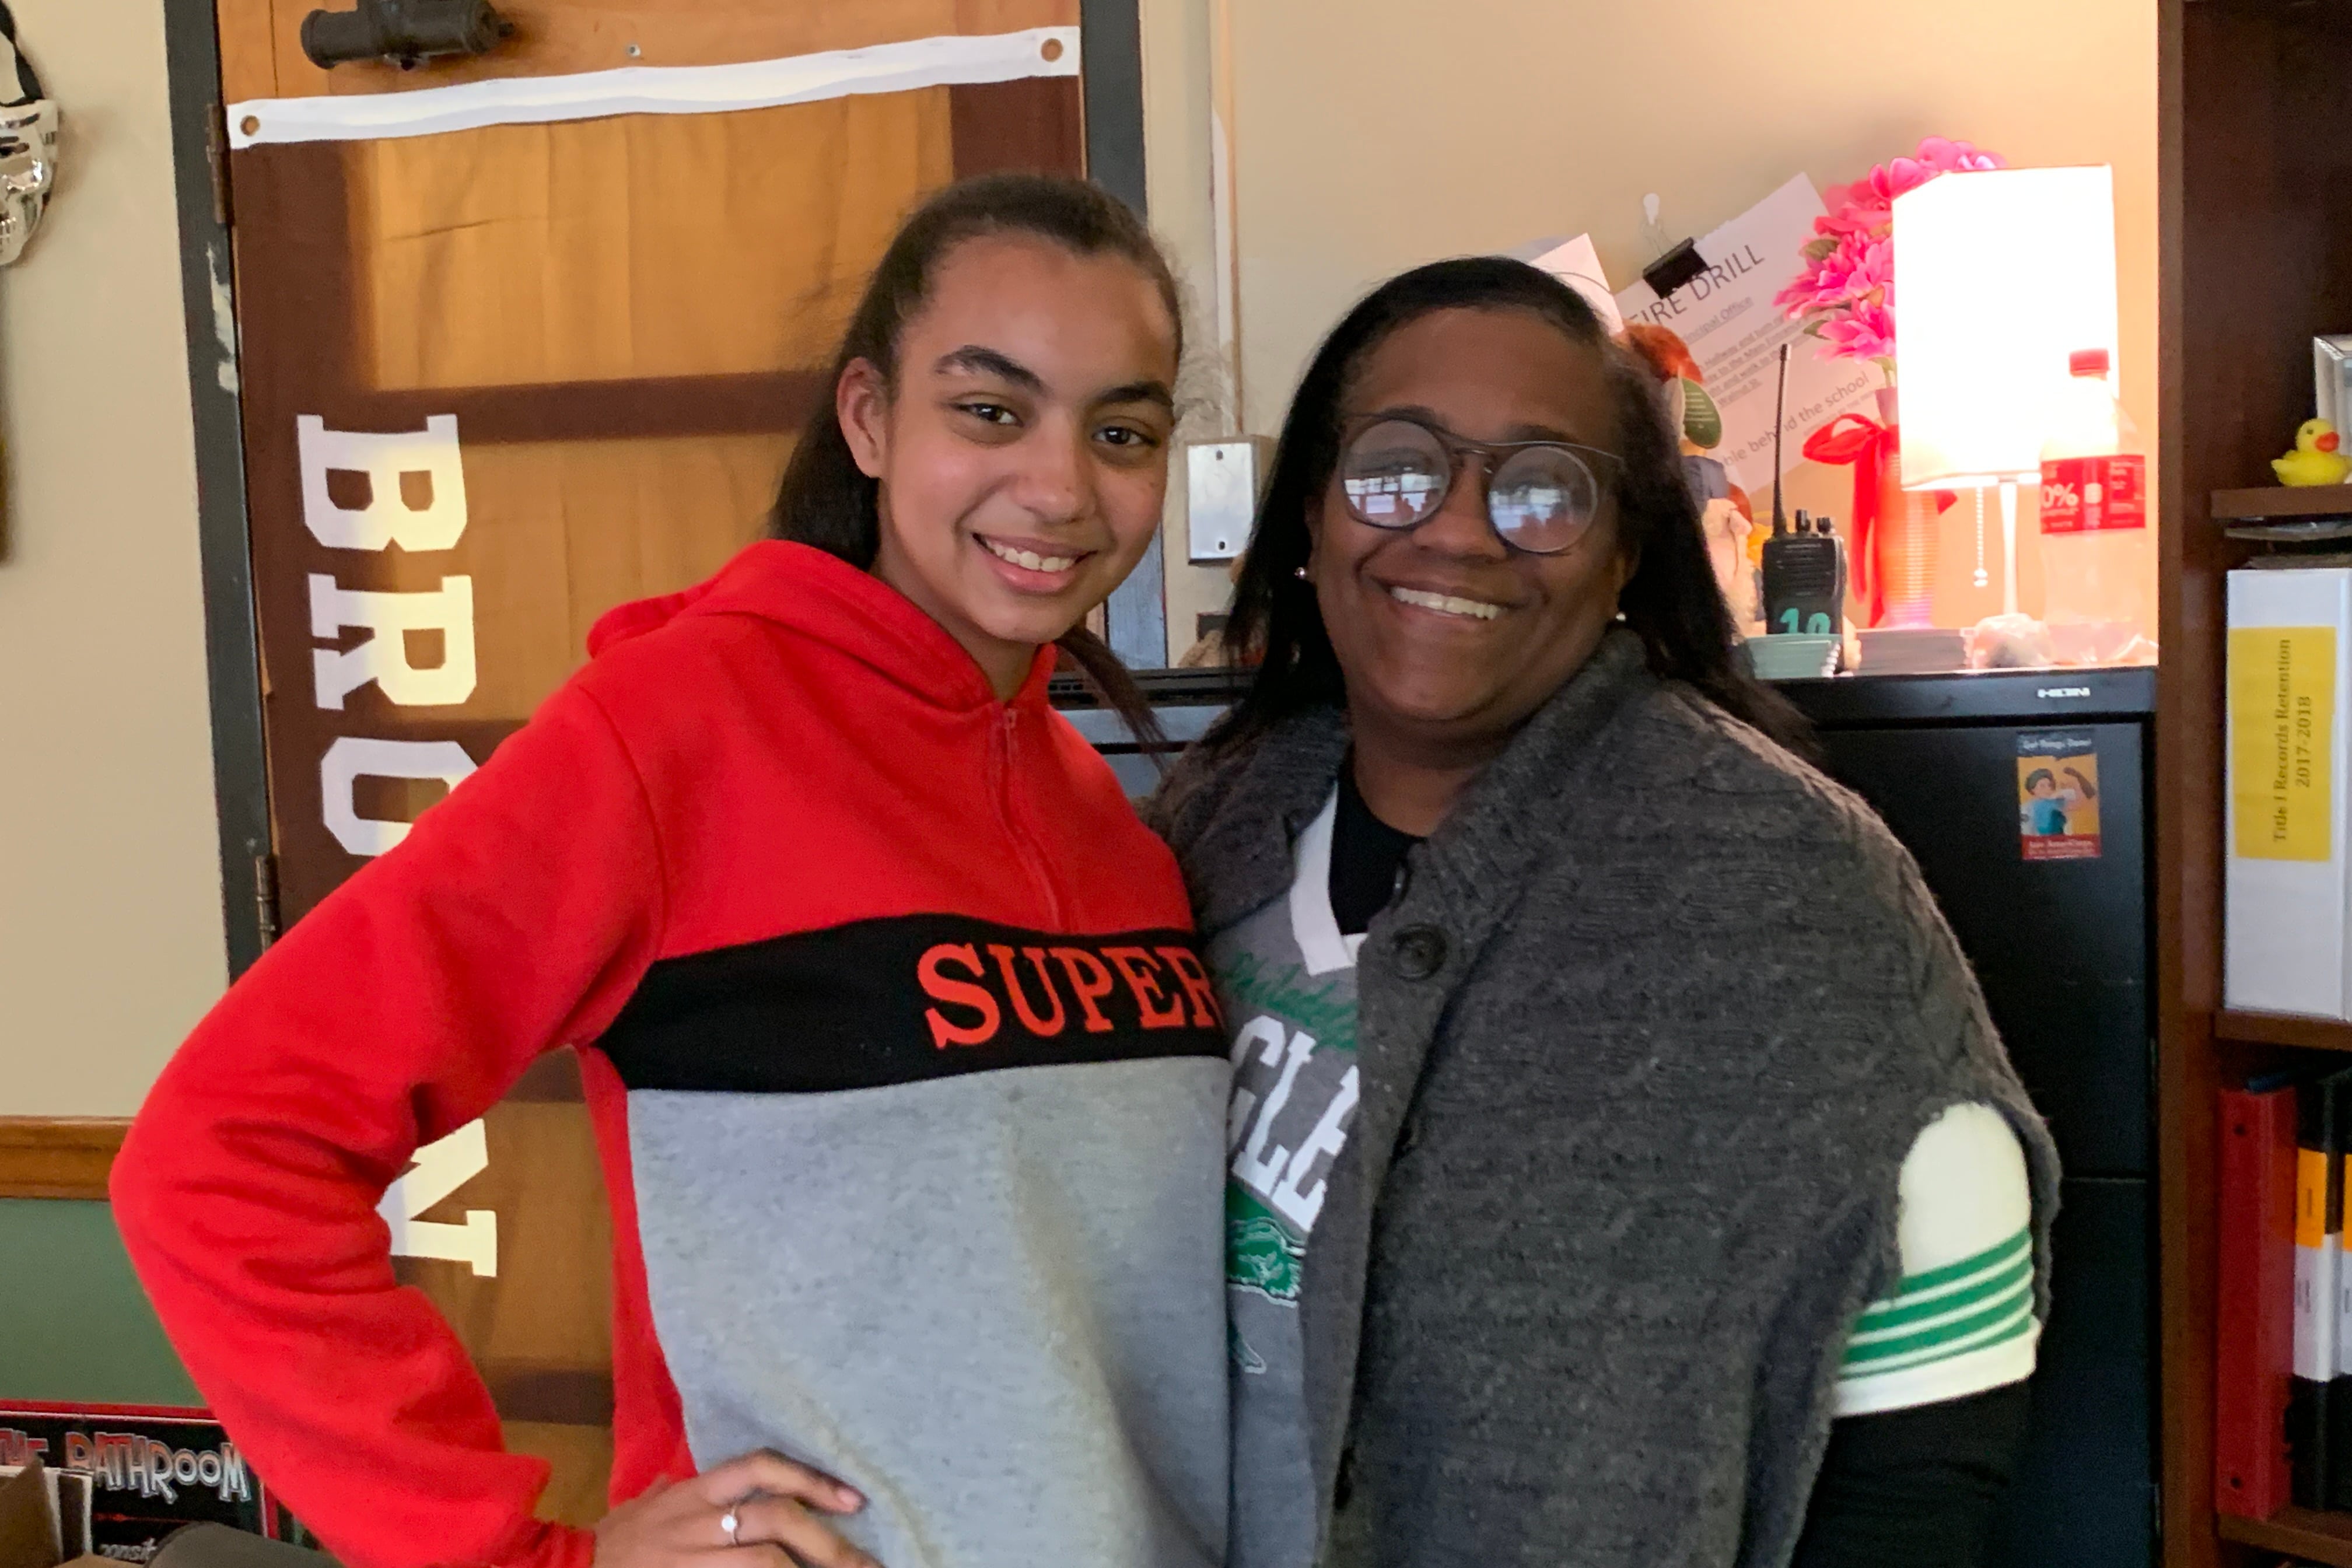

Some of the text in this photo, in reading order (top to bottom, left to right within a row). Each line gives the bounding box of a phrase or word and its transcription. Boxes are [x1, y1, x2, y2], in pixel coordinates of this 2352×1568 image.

[1630, 245, 1765, 324] IRE DRILL
[1720, 296, 1753, 320] Office
[1798, 402, 1824, 423] the
[1825, 369, 1870, 408] school
[2275, 638, 2291, 720] Retention
[2274, 724, 2290, 790] Records
[2295, 694, 2312, 788] 2017-2018
[2273, 807, 2287, 842] Title
[66, 1432, 251, 1504] BATHROOM
